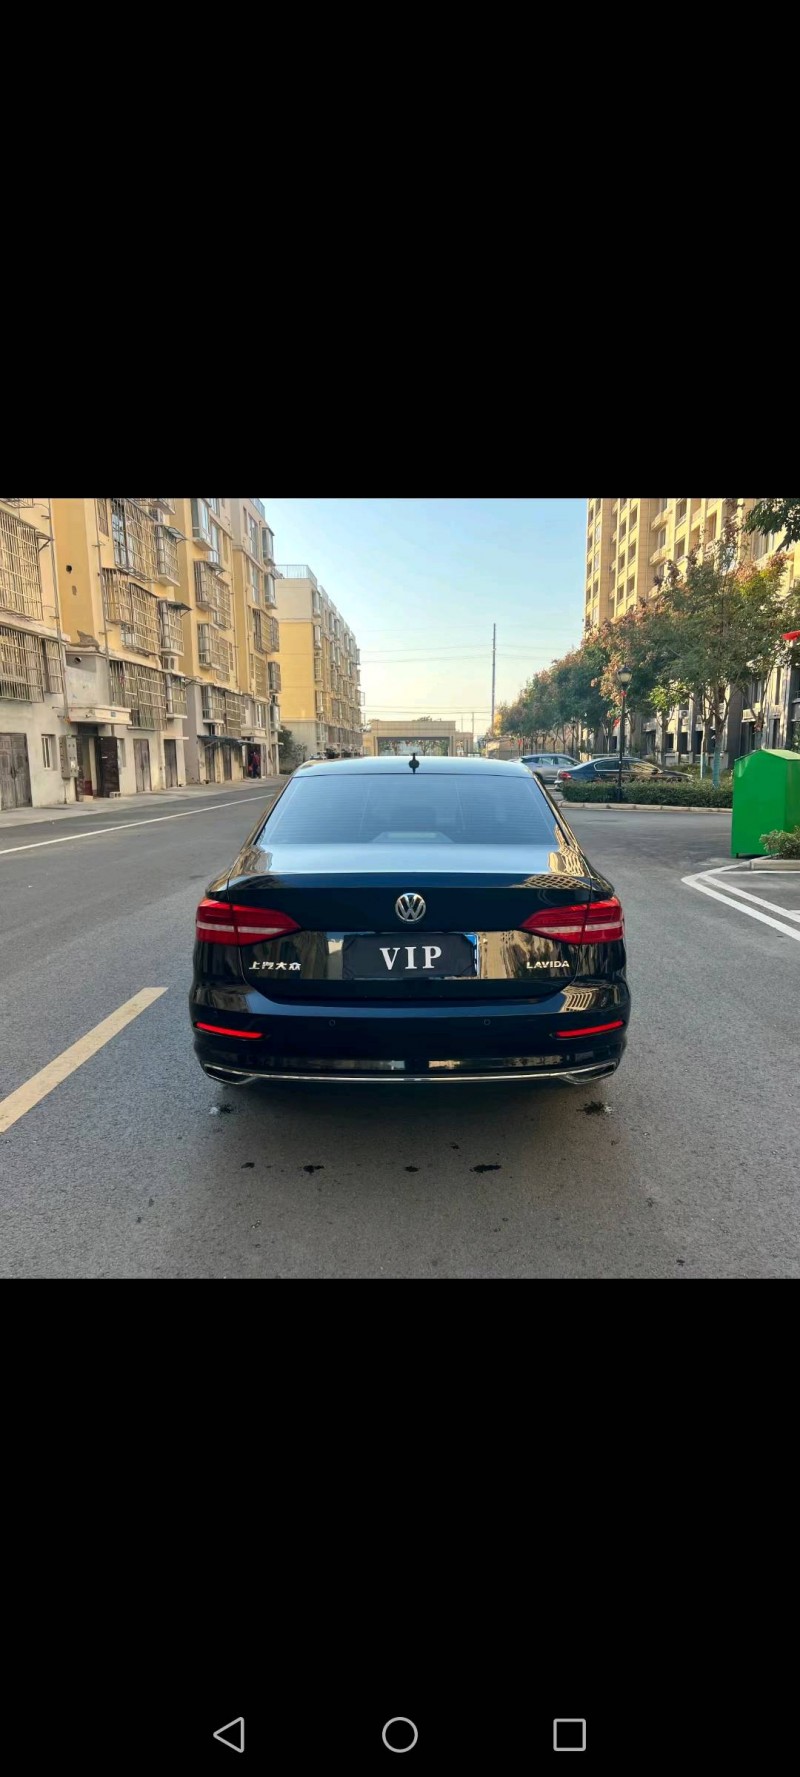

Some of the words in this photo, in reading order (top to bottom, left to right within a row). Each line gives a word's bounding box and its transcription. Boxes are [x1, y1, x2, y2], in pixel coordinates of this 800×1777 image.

[395, 893, 426, 922] VW
[248, 961, 302, 971] 上汽大众
[379, 945, 442, 971] VIP
[526, 960, 570, 969] LAVIDA
